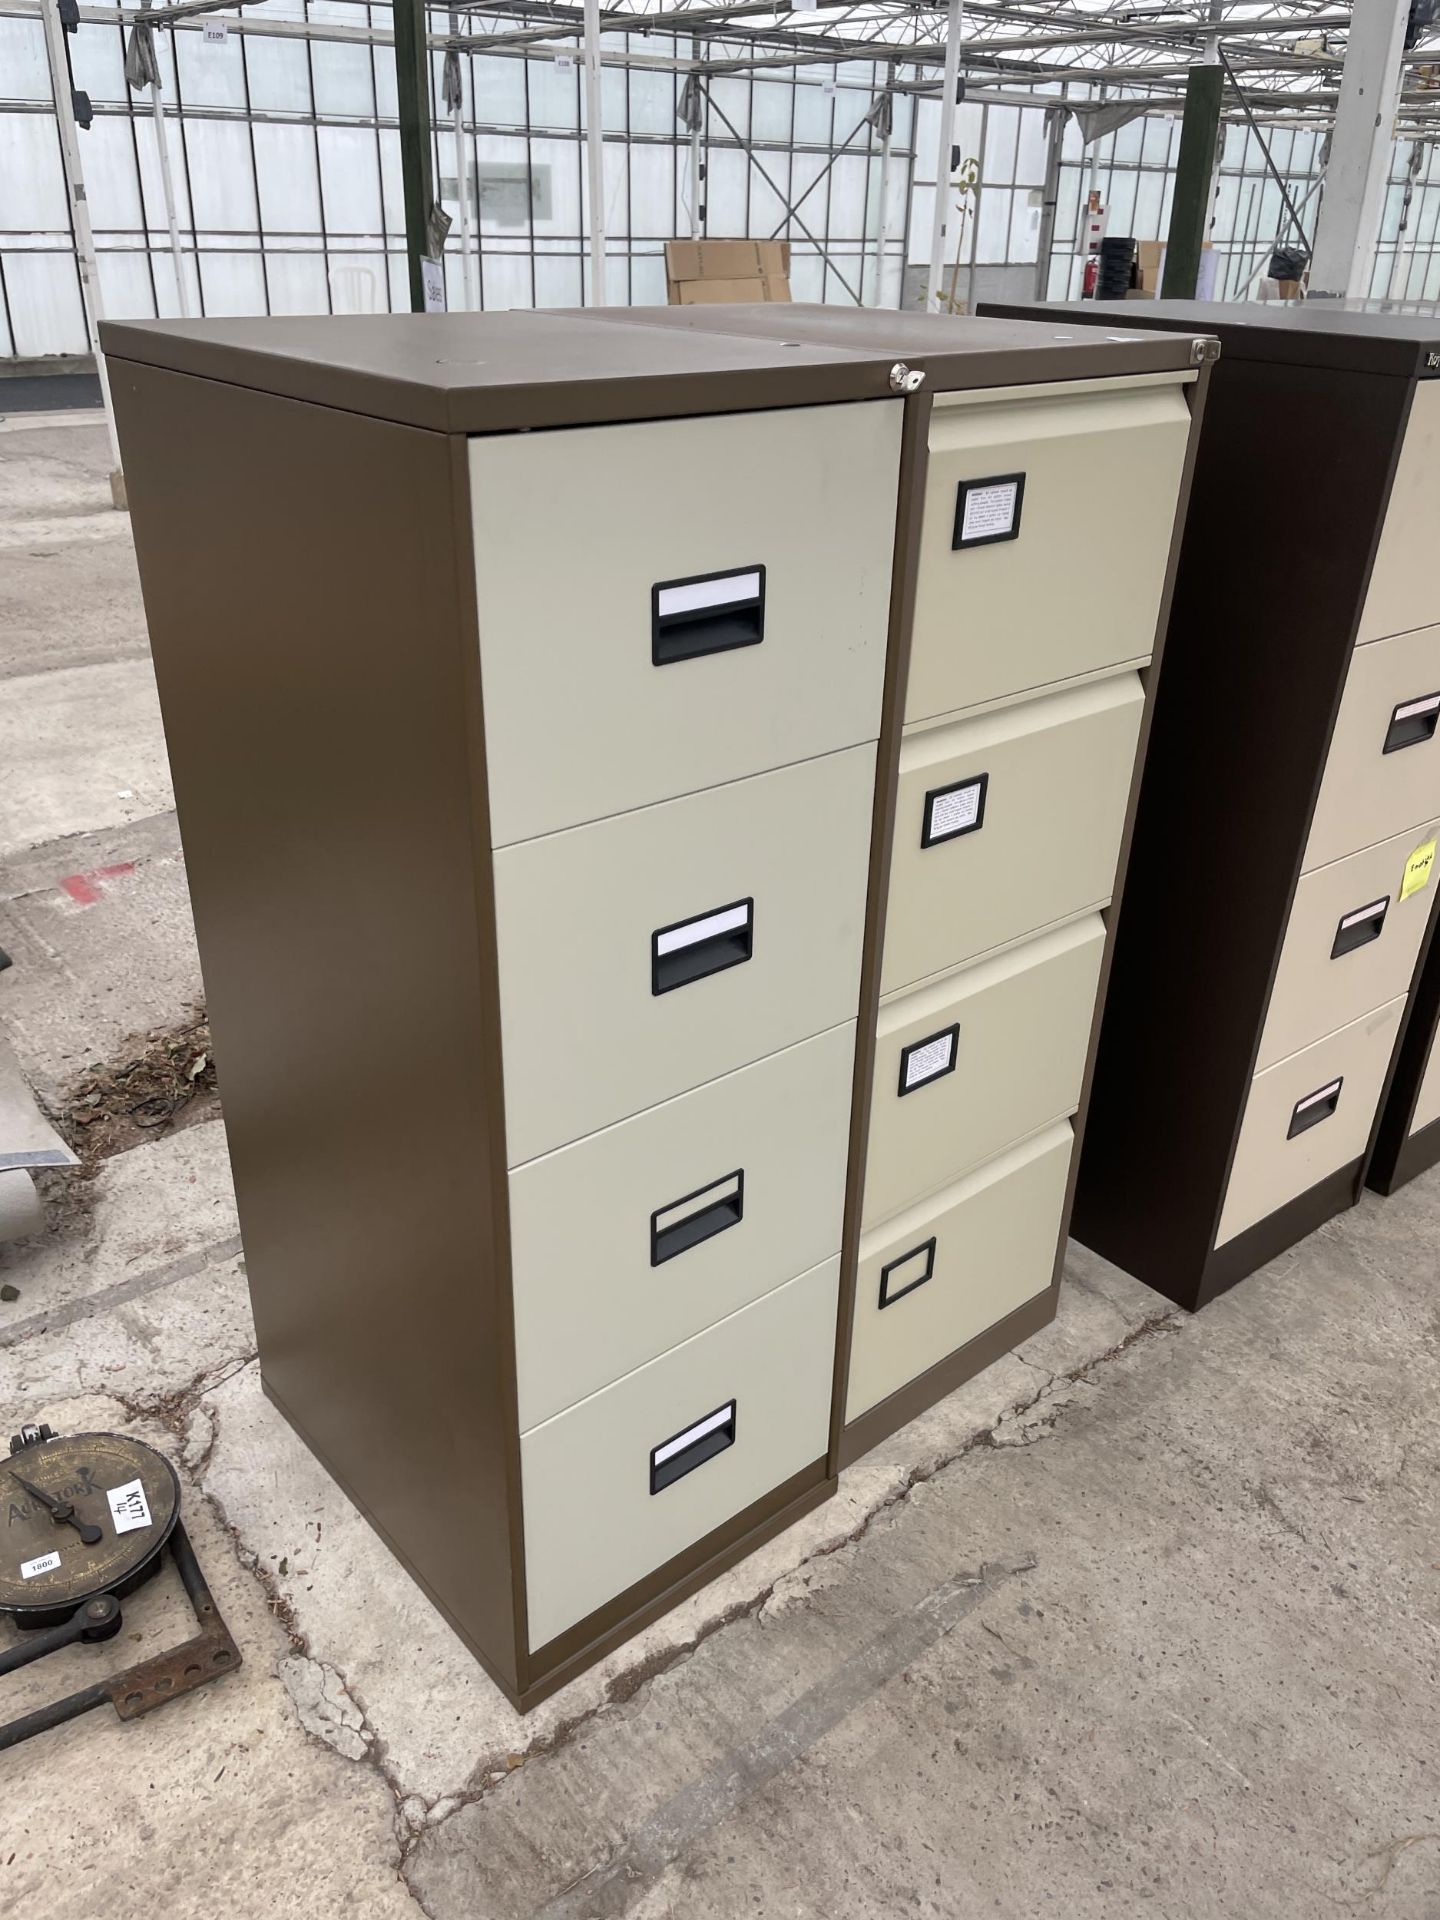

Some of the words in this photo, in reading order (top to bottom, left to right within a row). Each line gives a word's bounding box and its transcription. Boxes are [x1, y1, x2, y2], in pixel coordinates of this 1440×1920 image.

[207, 31, 224, 40] E109
[126, 1491, 145, 1520] K177
[32, 1560, 53, 1571] 1800
